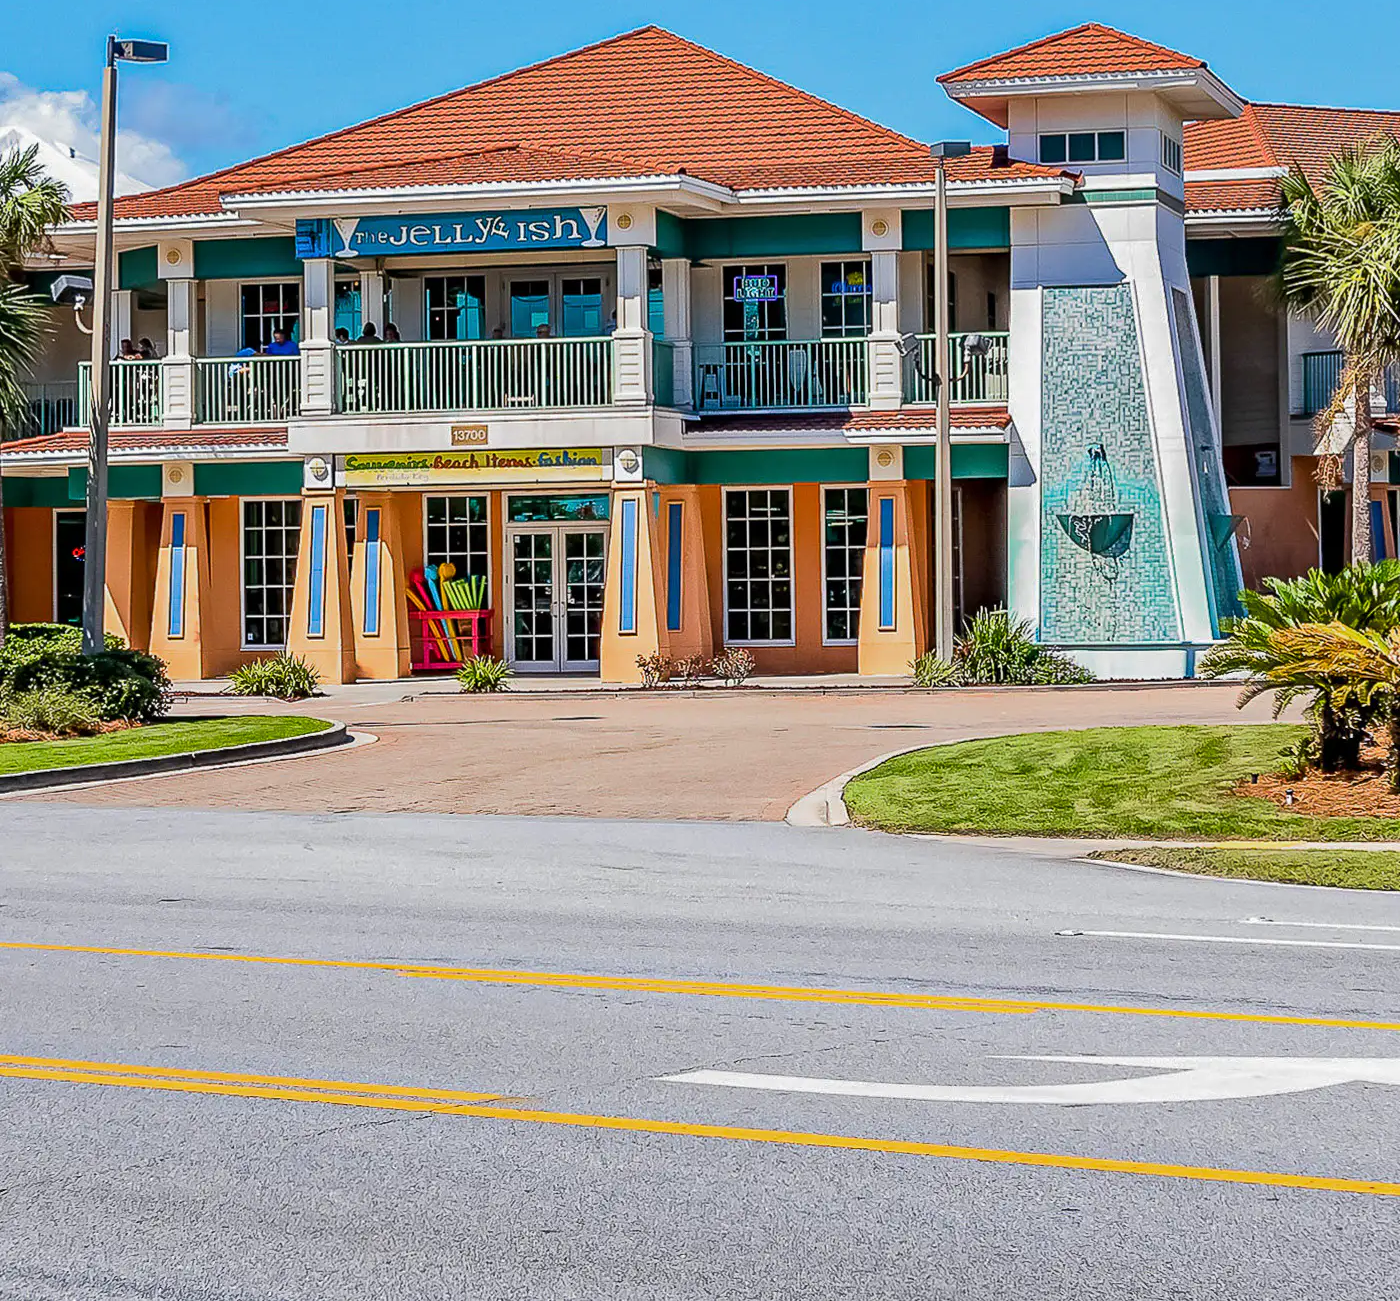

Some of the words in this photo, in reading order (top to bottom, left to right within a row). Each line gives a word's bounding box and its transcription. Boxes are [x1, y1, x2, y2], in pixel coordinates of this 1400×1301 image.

[355, 231, 389, 244] The
[453, 430, 486, 441] 13700
[345, 456, 430, 471] Souvenirs
[433, 453, 479, 469] Beach
[486, 452, 533, 468] Items
